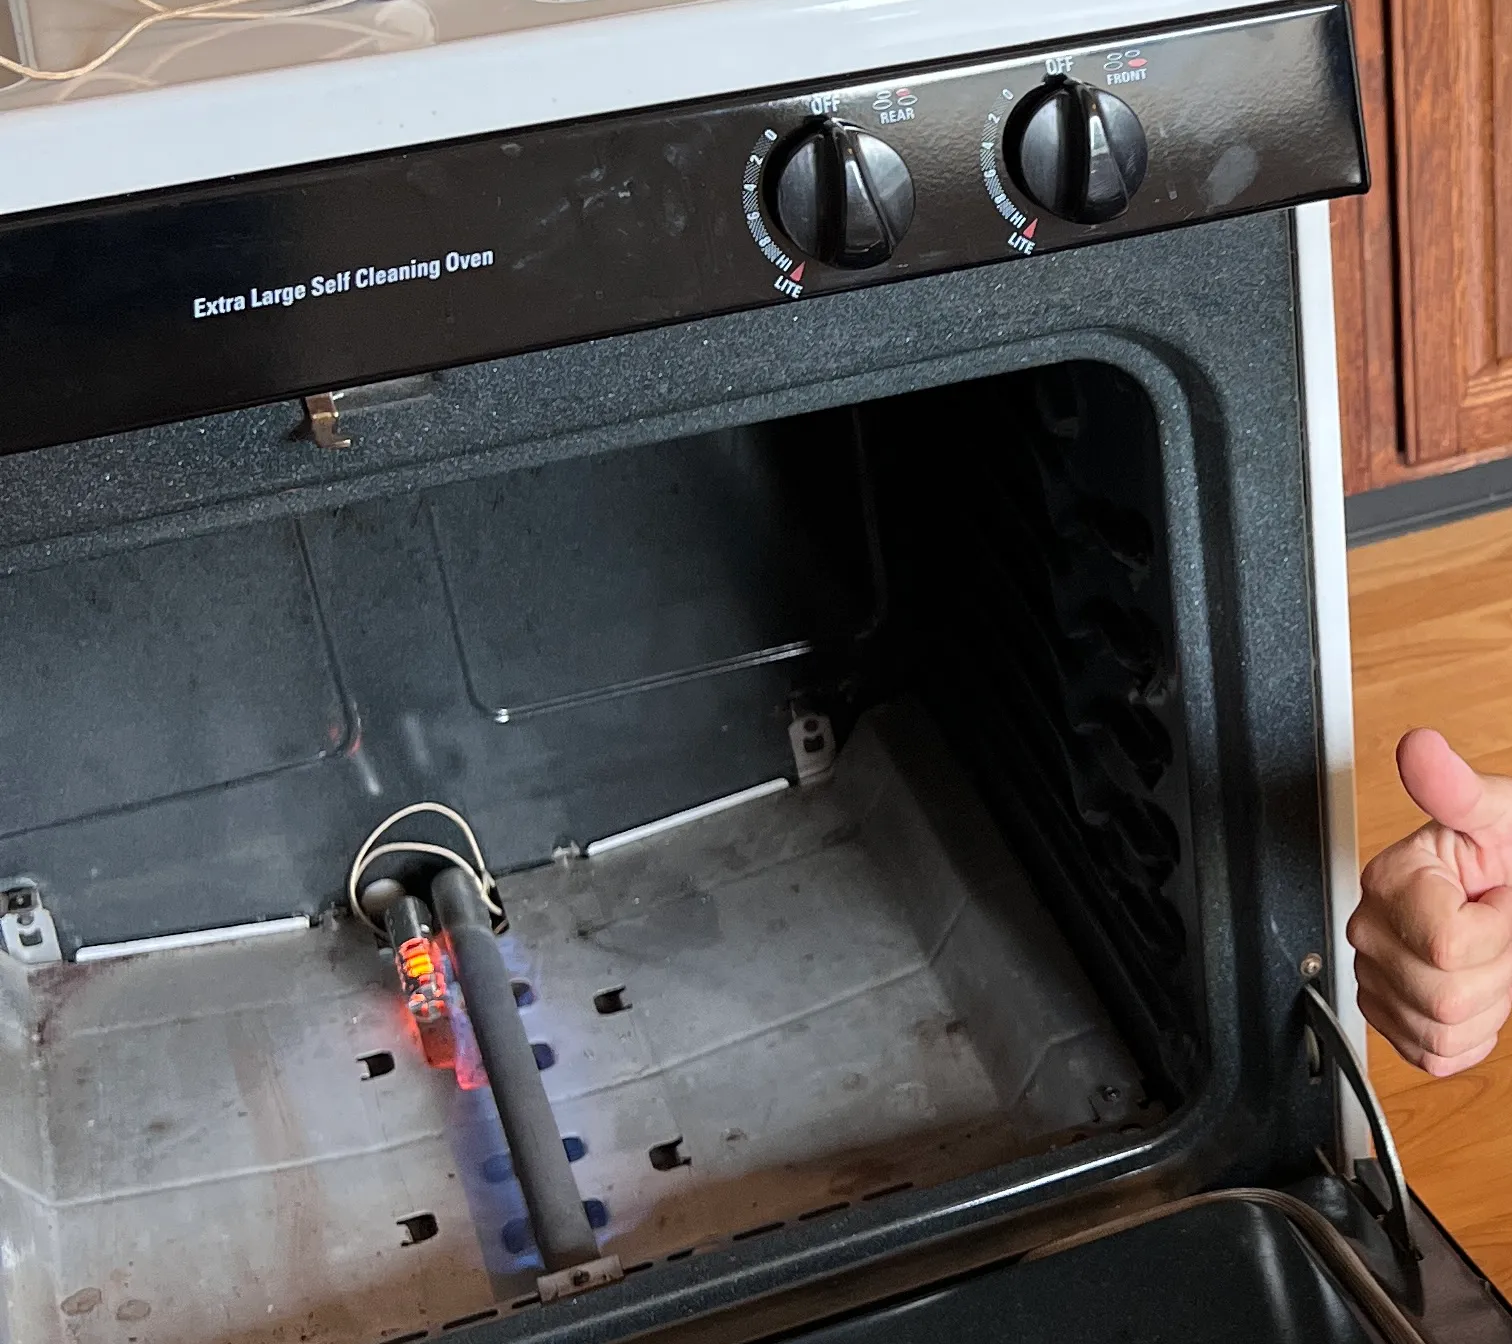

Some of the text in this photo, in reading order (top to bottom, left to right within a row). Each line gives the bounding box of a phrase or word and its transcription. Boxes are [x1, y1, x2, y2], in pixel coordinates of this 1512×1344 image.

[1045, 56, 1074, 75] OFF
[1106, 68, 1148, 86] FRONT
[810, 95, 840, 115] OFF
[880, 108, 915, 124] REAR
[988, 113, 1000, 124] 2
[1009, 211, 1027, 229] HI
[750, 154, 763, 165] 2
[775, 253, 792, 272] HI
[1008, 232, 1036, 256] LITE
[193, 248, 494, 319] Extra Large Self Cleaning Oven
[774, 275, 804, 299] LITE
